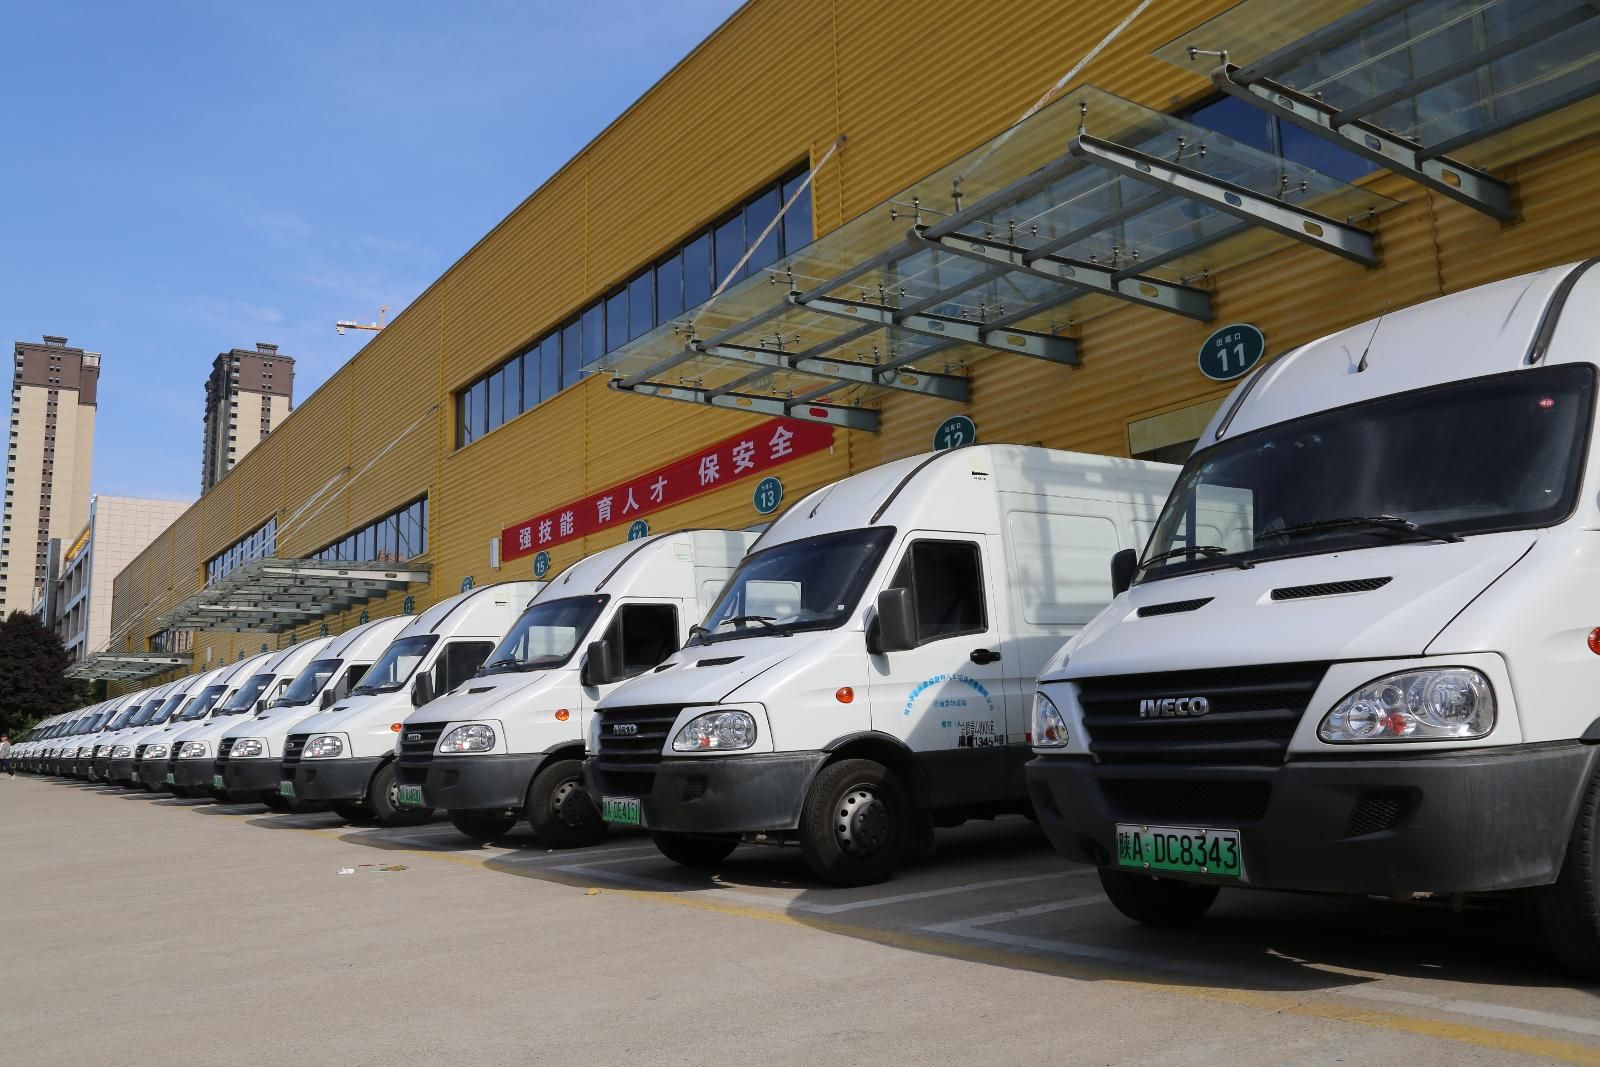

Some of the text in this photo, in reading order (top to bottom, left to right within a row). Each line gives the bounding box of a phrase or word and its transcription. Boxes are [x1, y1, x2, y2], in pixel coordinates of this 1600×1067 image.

[1217, 343, 1246, 372] 11
[944, 431, 964, 449] 12
[518, 425, 794, 551] 强技能 育人才 保安全
[760, 490, 775, 508] 13
[536, 562, 545, 574] 15
[1140, 696, 1209, 718] IVECO
